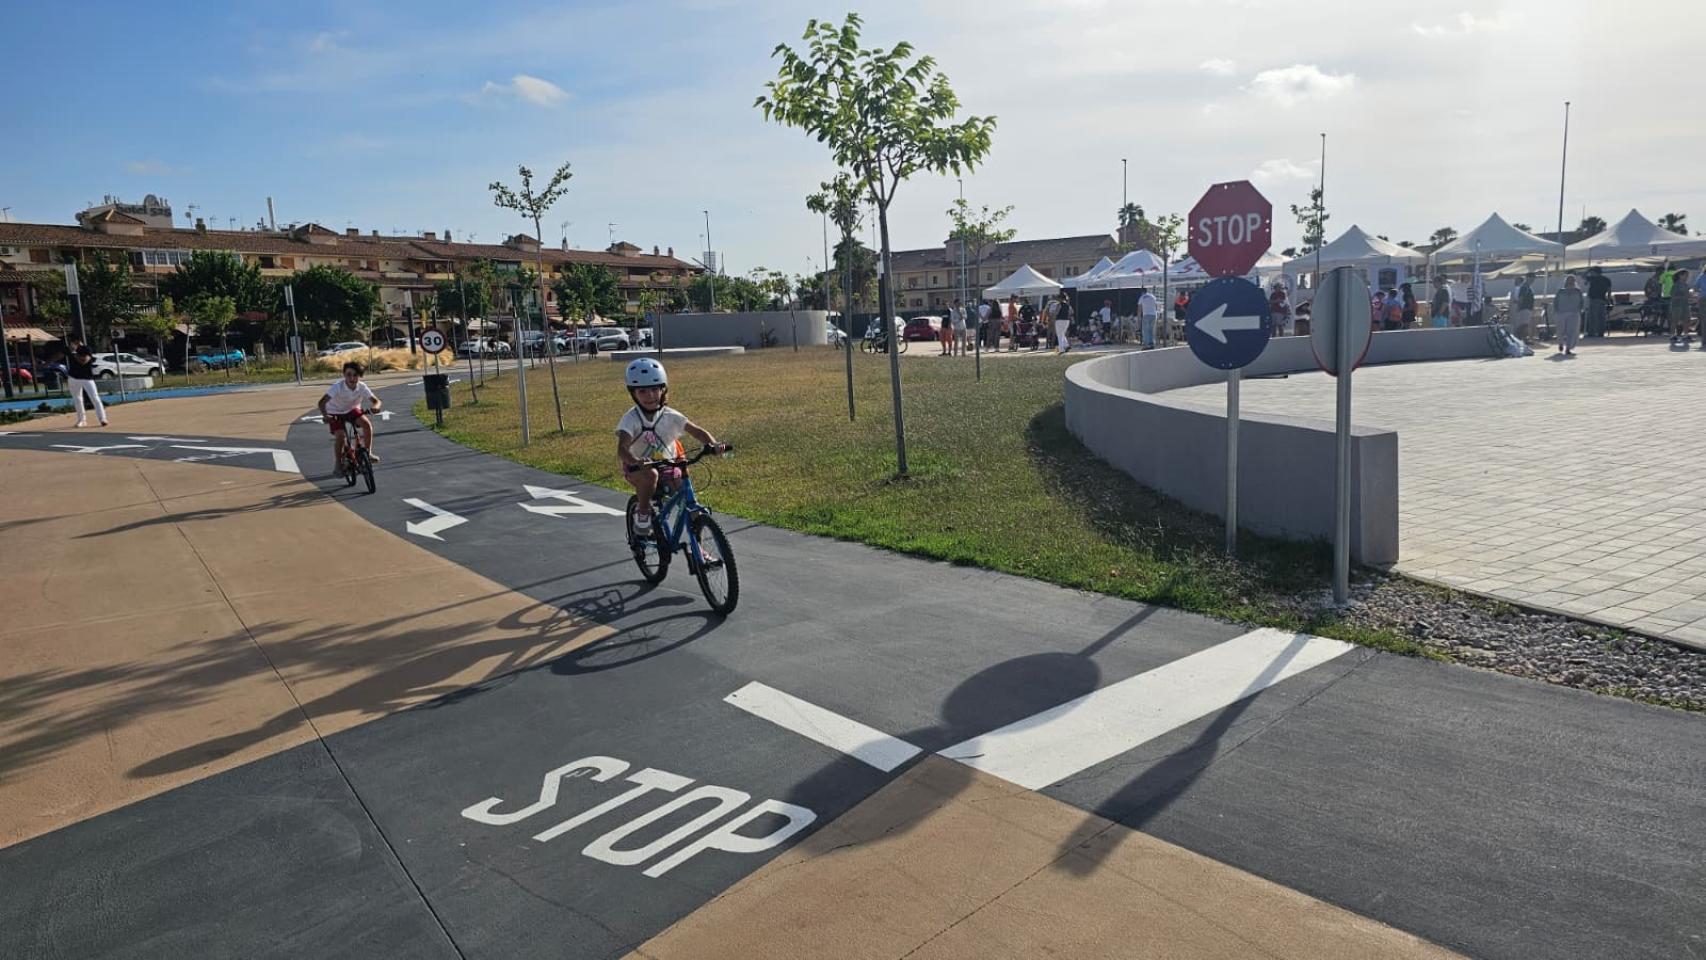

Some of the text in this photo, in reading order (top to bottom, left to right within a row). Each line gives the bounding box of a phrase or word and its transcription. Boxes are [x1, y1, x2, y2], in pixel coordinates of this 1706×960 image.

[1197, 212, 1261, 247] STOP
[424, 336, 442, 347] 30
[460, 754, 818, 879] STOP
